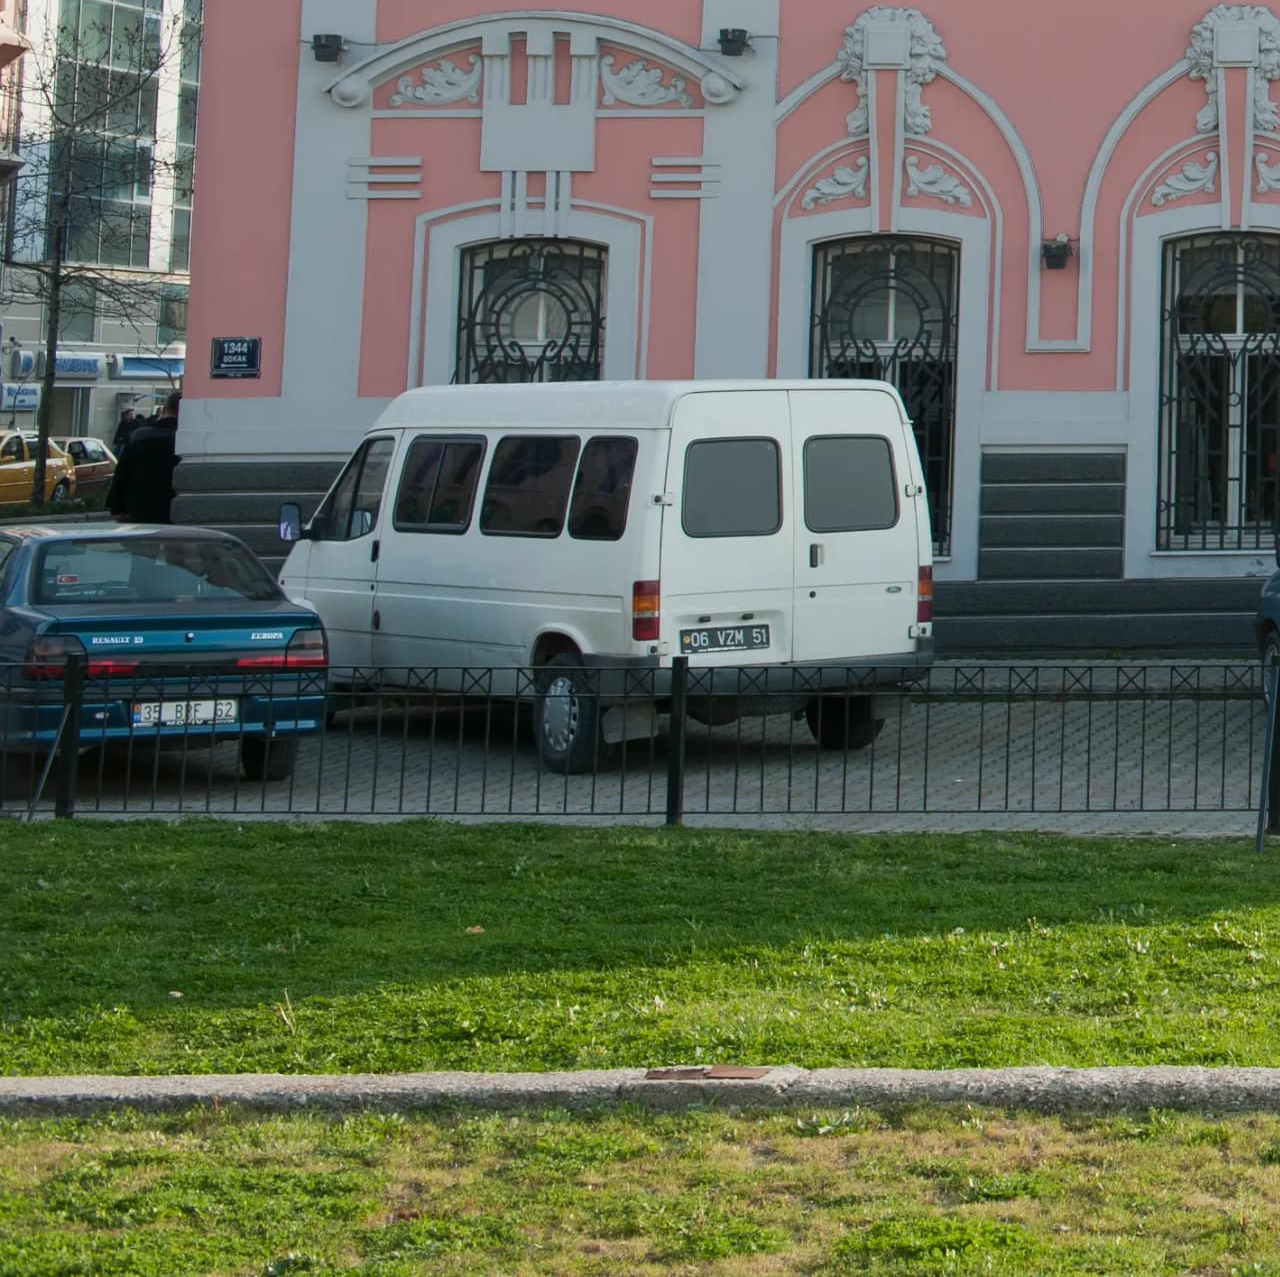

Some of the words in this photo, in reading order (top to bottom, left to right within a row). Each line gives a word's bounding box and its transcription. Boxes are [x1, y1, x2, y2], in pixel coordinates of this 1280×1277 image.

[223, 342, 248, 353] 1344
[223, 354, 248, 363] SOKAK
[691, 631, 709, 647] 06
[717, 629, 744, 645] VZM
[752, 628, 767, 643] 51
[143, 705, 160, 721] 35
[215, 702, 233, 718] 62
